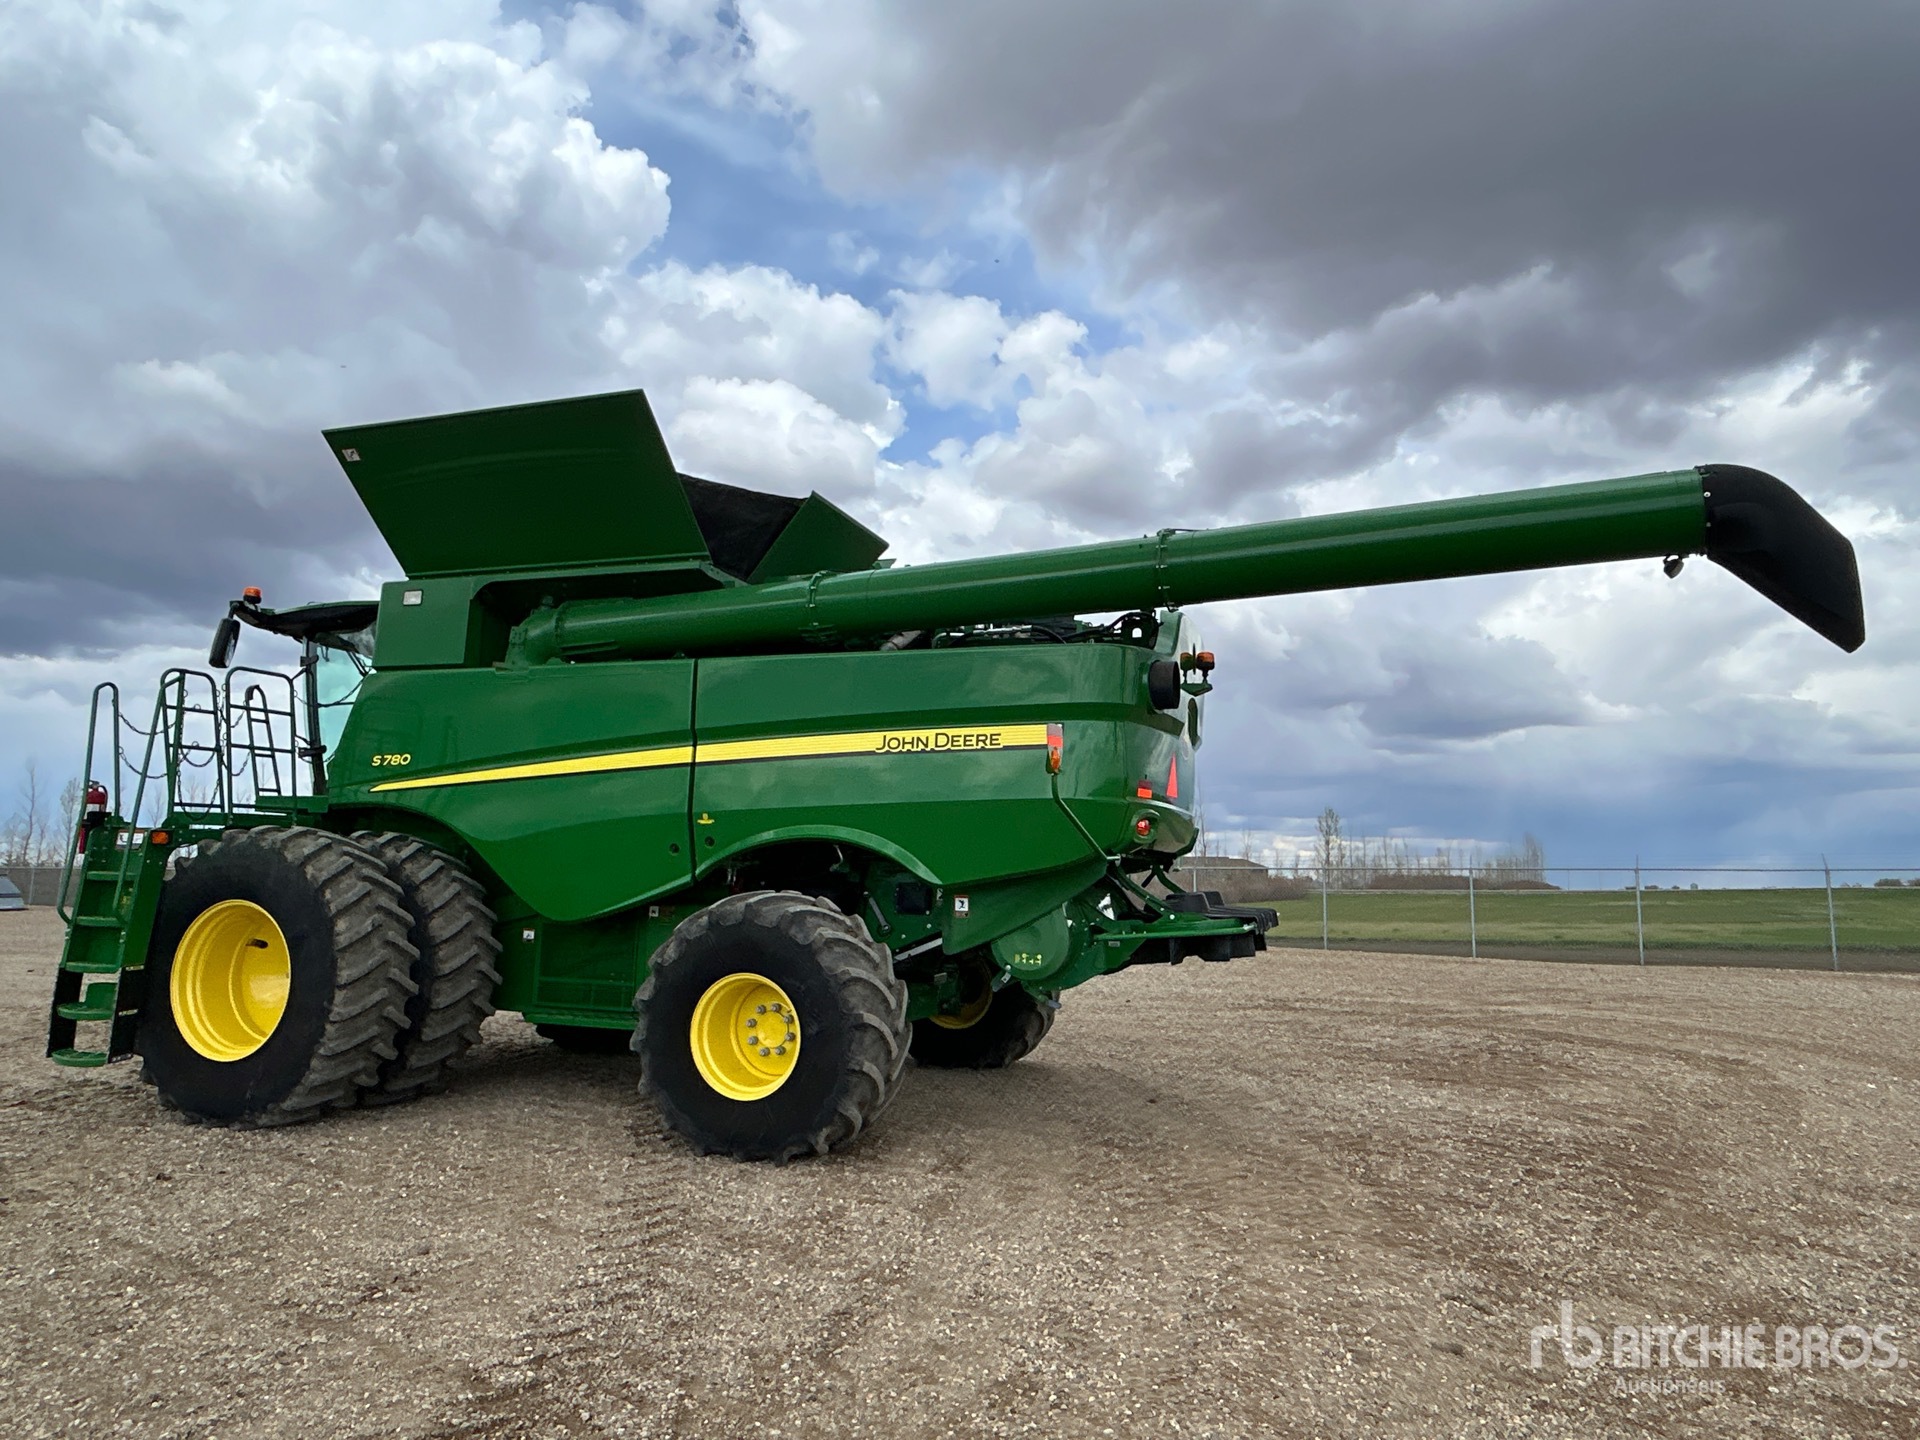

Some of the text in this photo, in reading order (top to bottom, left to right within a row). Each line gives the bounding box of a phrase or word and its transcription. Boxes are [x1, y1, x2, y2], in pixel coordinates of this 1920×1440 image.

[875, 732, 1002, 751] JOHN DEERE
[371, 753, 411, 766] S780
